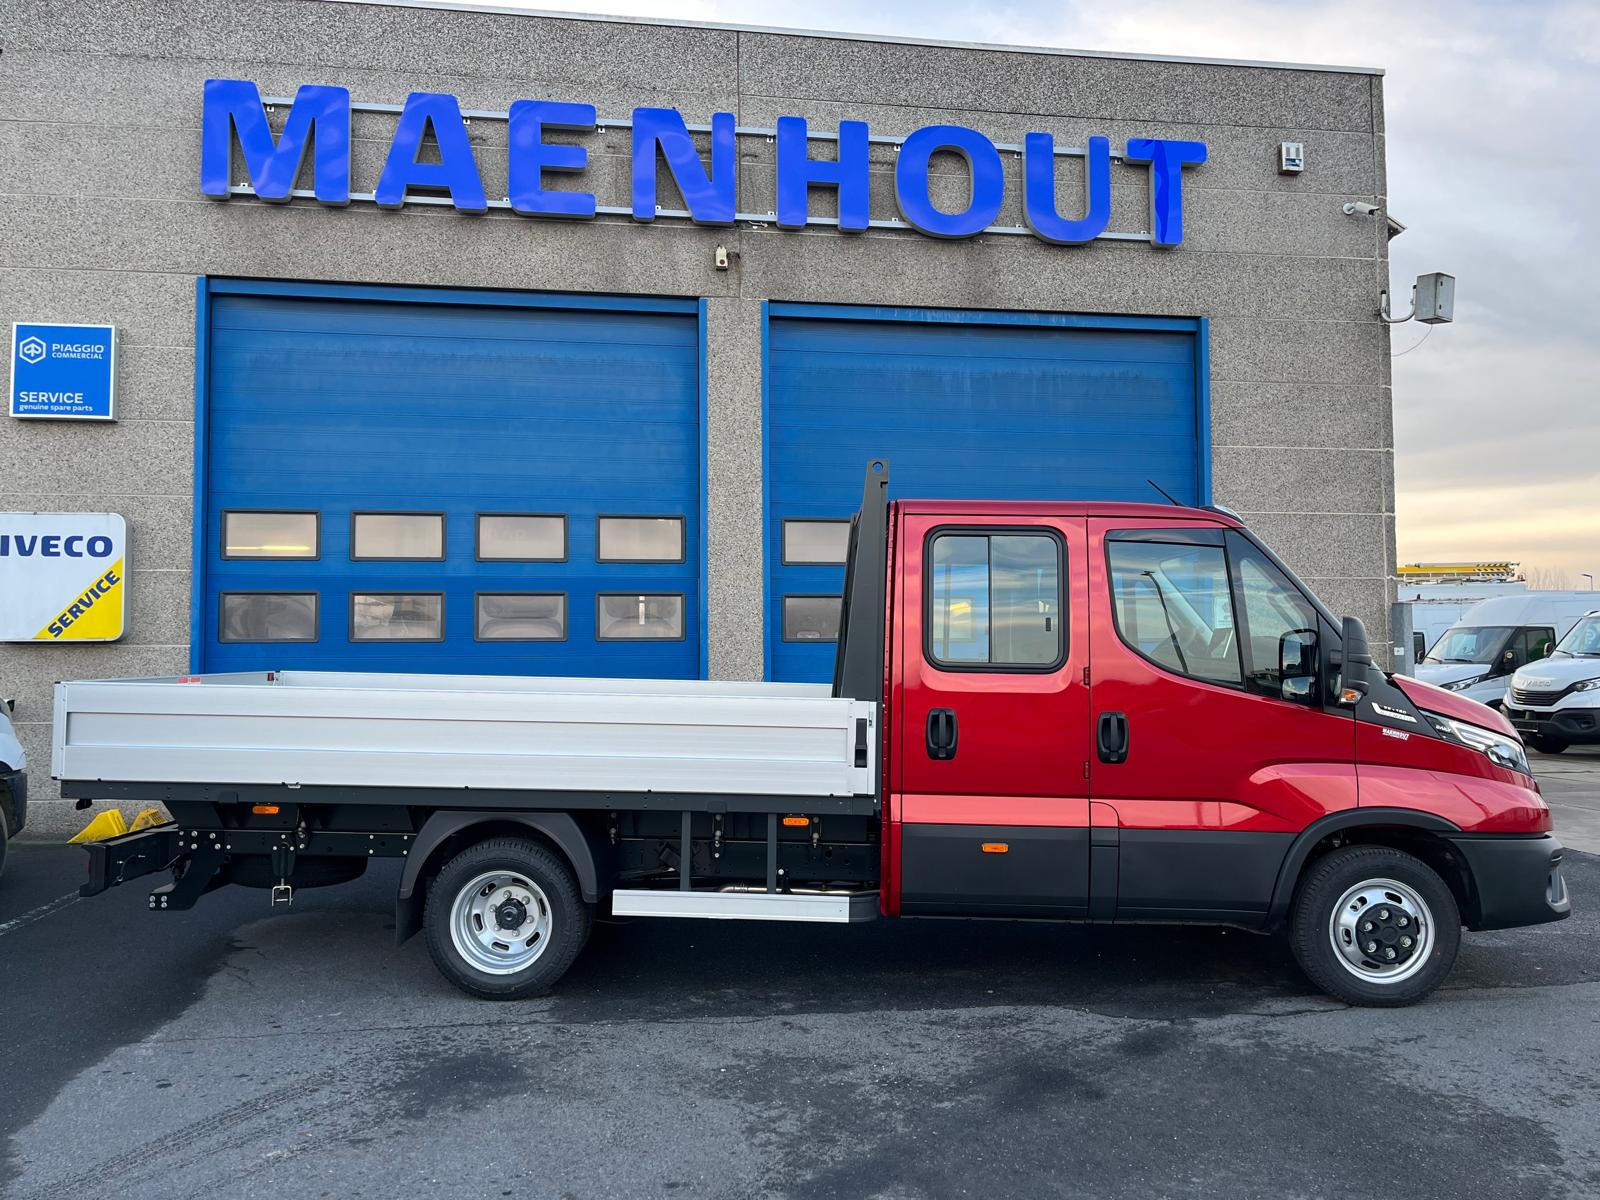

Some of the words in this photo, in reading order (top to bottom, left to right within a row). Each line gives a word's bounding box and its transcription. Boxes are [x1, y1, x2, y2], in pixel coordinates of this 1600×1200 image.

[201, 79, 1208, 248] MAENHOUT
[52, 343, 105, 353] PIAGGIO
[52, 352, 103, 360] COMMERCIAL
[19, 391, 84, 404] SERVICE
[19, 404, 49, 412] genuine
[0, 534, 113, 558] IVECO
[47, 570, 121, 638] SERVICE
